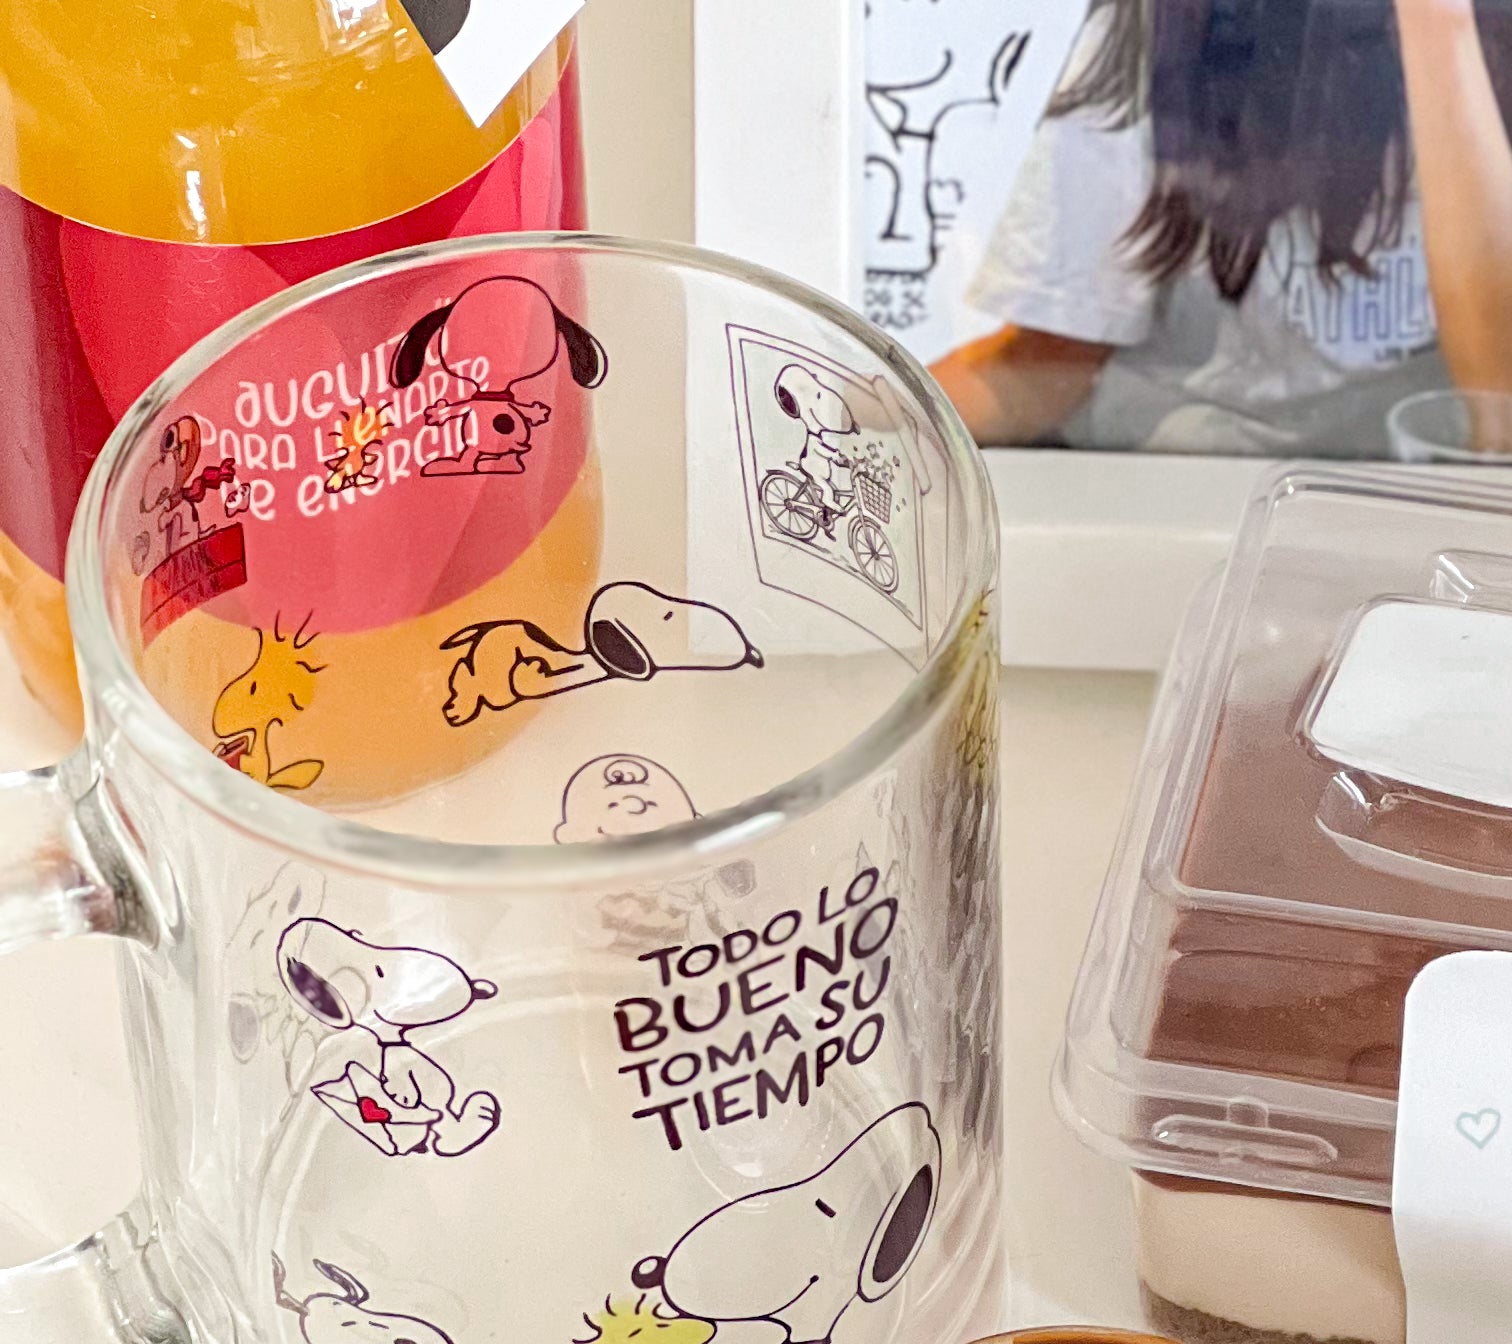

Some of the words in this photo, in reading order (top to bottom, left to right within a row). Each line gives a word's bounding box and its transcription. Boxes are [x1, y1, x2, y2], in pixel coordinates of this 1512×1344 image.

[613, 897, 899, 1052] BUENO
[637, 909, 802, 987] TODO
[818, 867, 880, 924] LO
[618, 1013, 802, 1097] TOMA
[815, 955, 891, 1030] SU
[632, 1013, 884, 1150] TIEMPO
